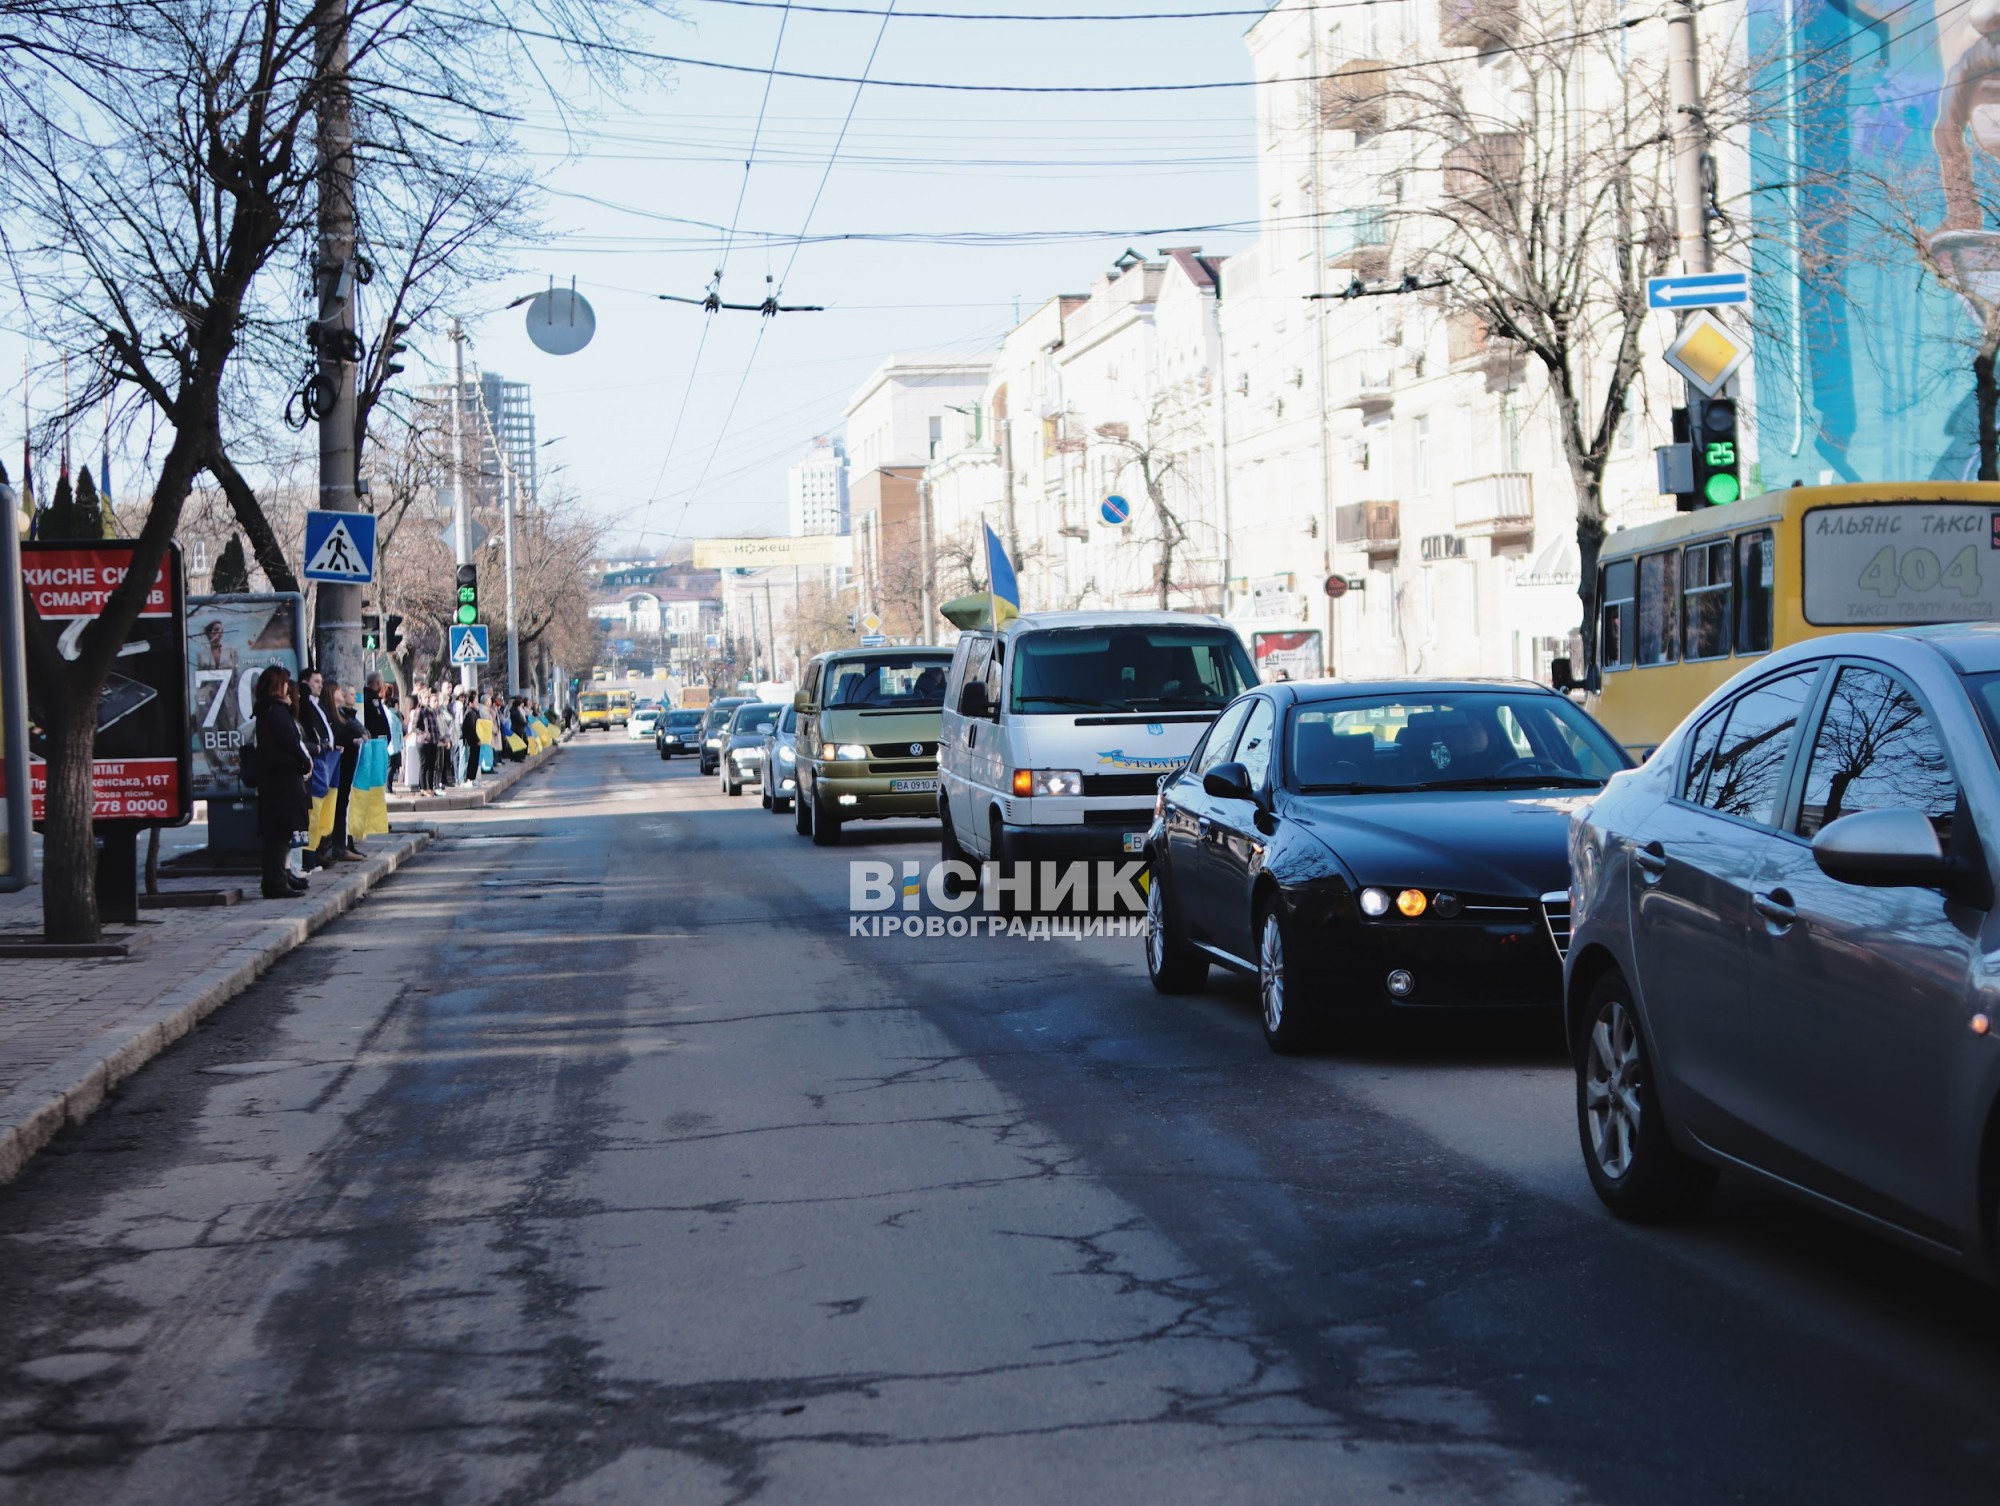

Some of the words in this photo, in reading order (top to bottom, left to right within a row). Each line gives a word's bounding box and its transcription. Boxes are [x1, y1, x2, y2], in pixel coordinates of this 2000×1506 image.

[1706, 442, 1735, 466] 25
[1816, 515, 1902, 535] АЛЬЯНС
[1921, 514, 1983, 534] ТАКСІ
[22, 568, 96, 585] ХИСНЕ
[1858, 544, 1983, 598] 404
[460, 587, 475, 602] 25
[1847, 604, 1889, 617] ТАКСІ
[204, 731, 245, 749] BER
[93, 764, 125, 775] НТАКТ
[1123, 757, 1188, 769] УКРАЇН
[896, 781, 909, 790] BA
[910, 781, 930, 790] 0910
[127, 799, 167, 812] 0000
[1134, 836, 1142, 849] B
